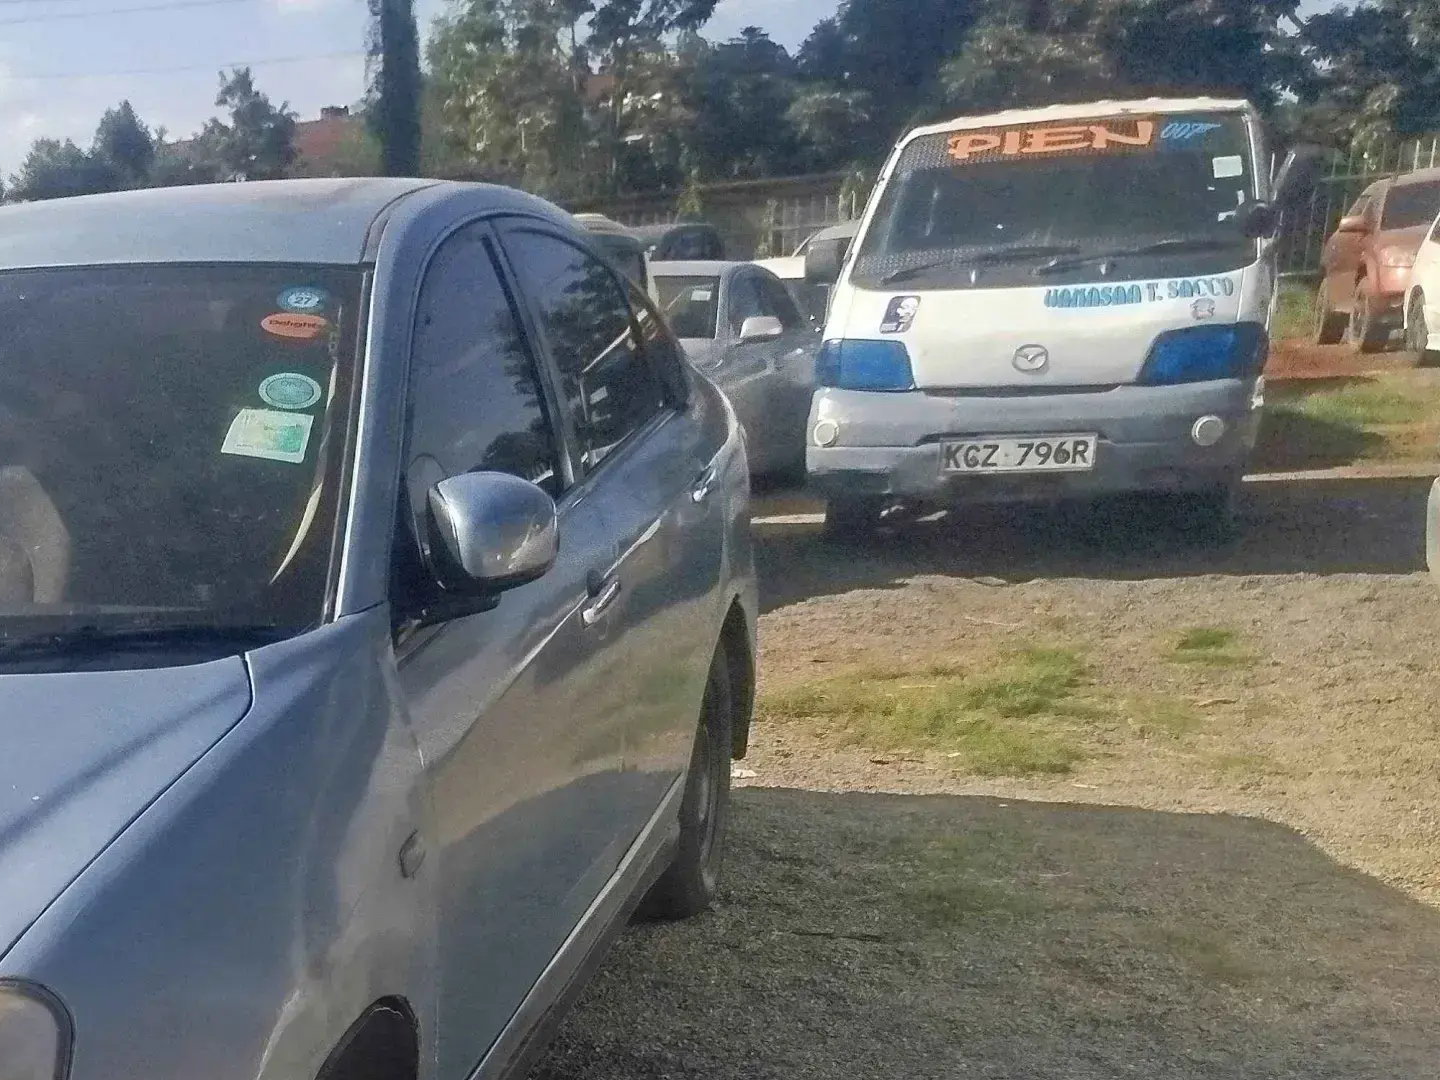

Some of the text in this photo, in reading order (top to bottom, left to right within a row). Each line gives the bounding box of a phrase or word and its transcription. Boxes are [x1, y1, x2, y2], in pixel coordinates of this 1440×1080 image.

[947, 120, 1153, 159] PIEN
[1146, 282, 1163, 301] T.
[1167, 276, 1234, 299] SACCO
[1016, 439, 1089, 466] 796R
